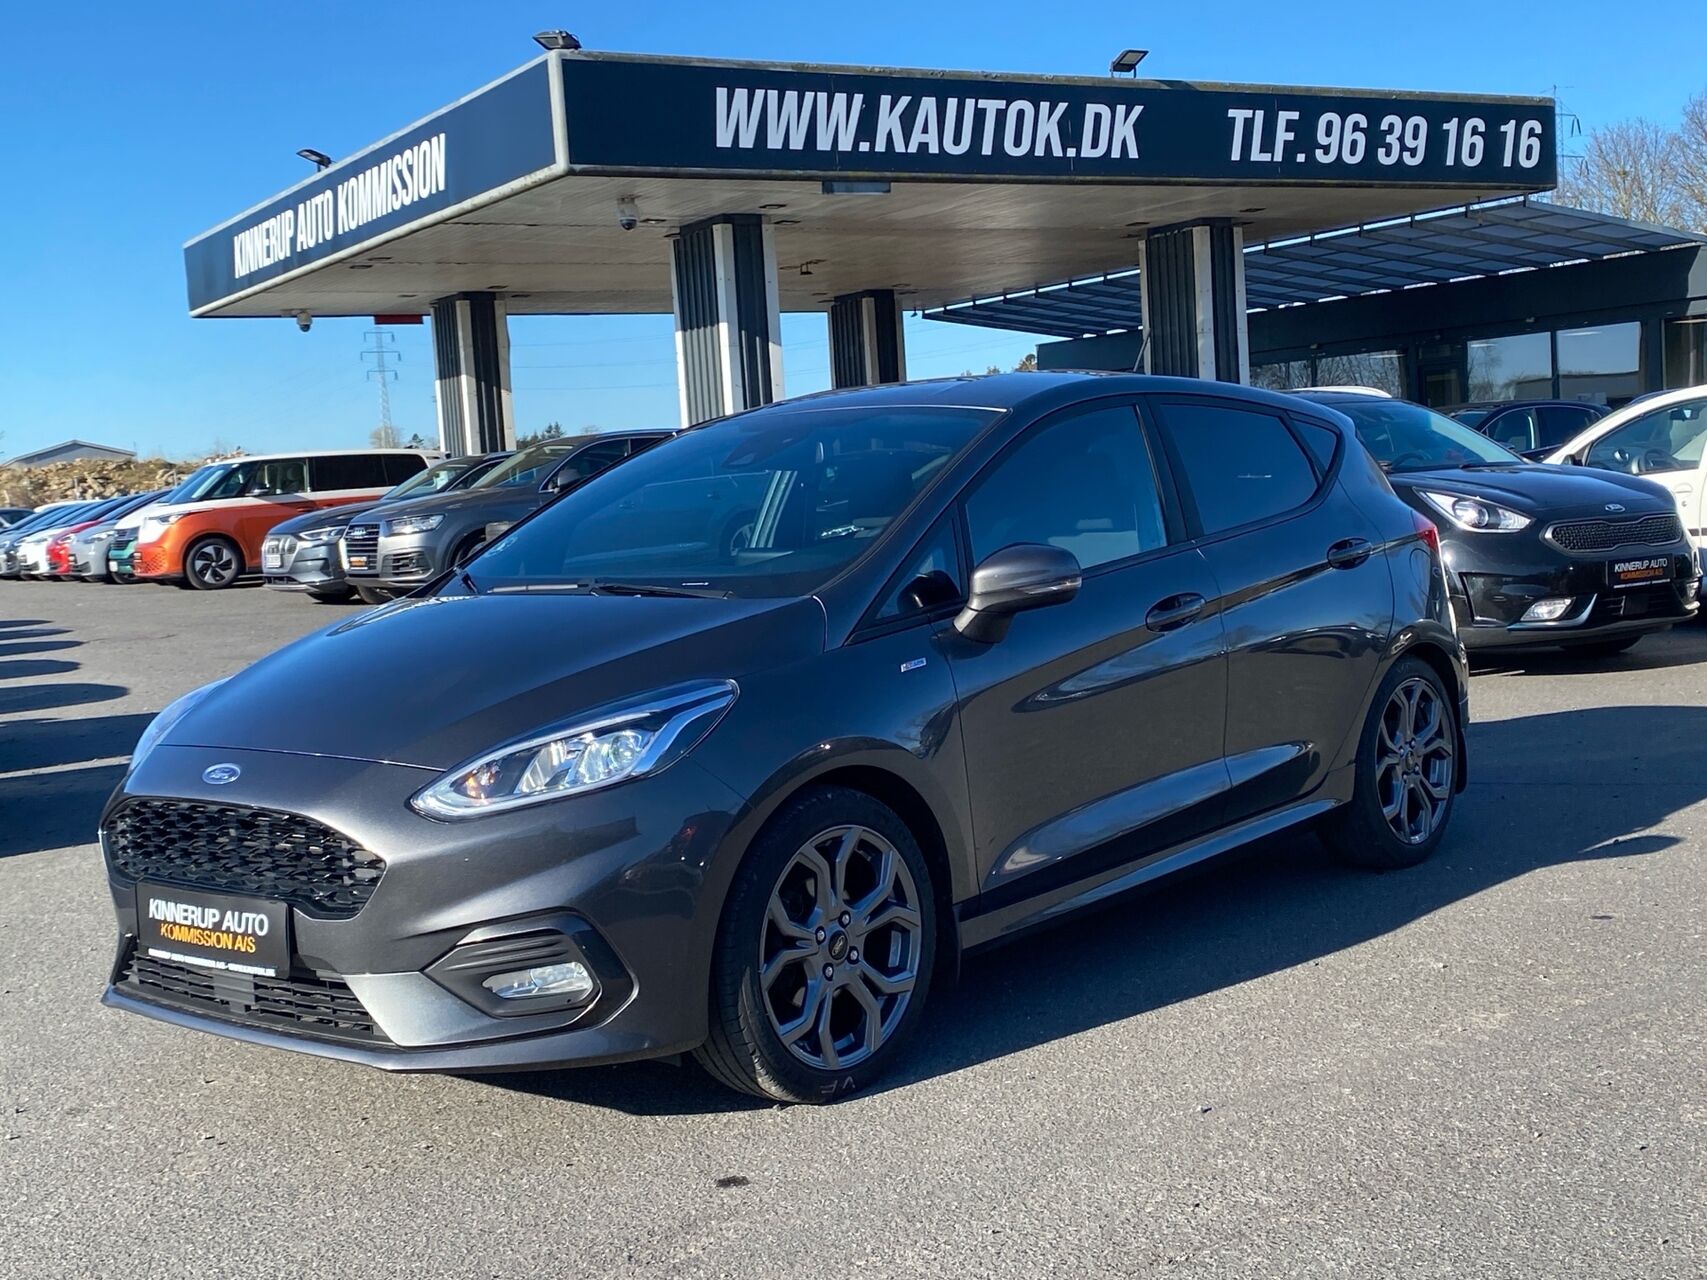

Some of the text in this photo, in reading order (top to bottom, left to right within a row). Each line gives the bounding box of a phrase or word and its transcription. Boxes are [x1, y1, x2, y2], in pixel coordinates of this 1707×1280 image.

[715, 86, 1145, 160] WWW.KAUTOK.DK
[1227, 108, 1543, 169] TLF. 96 39 16 16
[234, 132, 446, 279] KINNERUP AUTO KOMMISSION
[1614, 559, 1668, 573] KINNERUP AUTO
[148, 898, 269, 936] KINNERUP AUTO
[160, 923, 257, 953] KOMMISSION A/S
